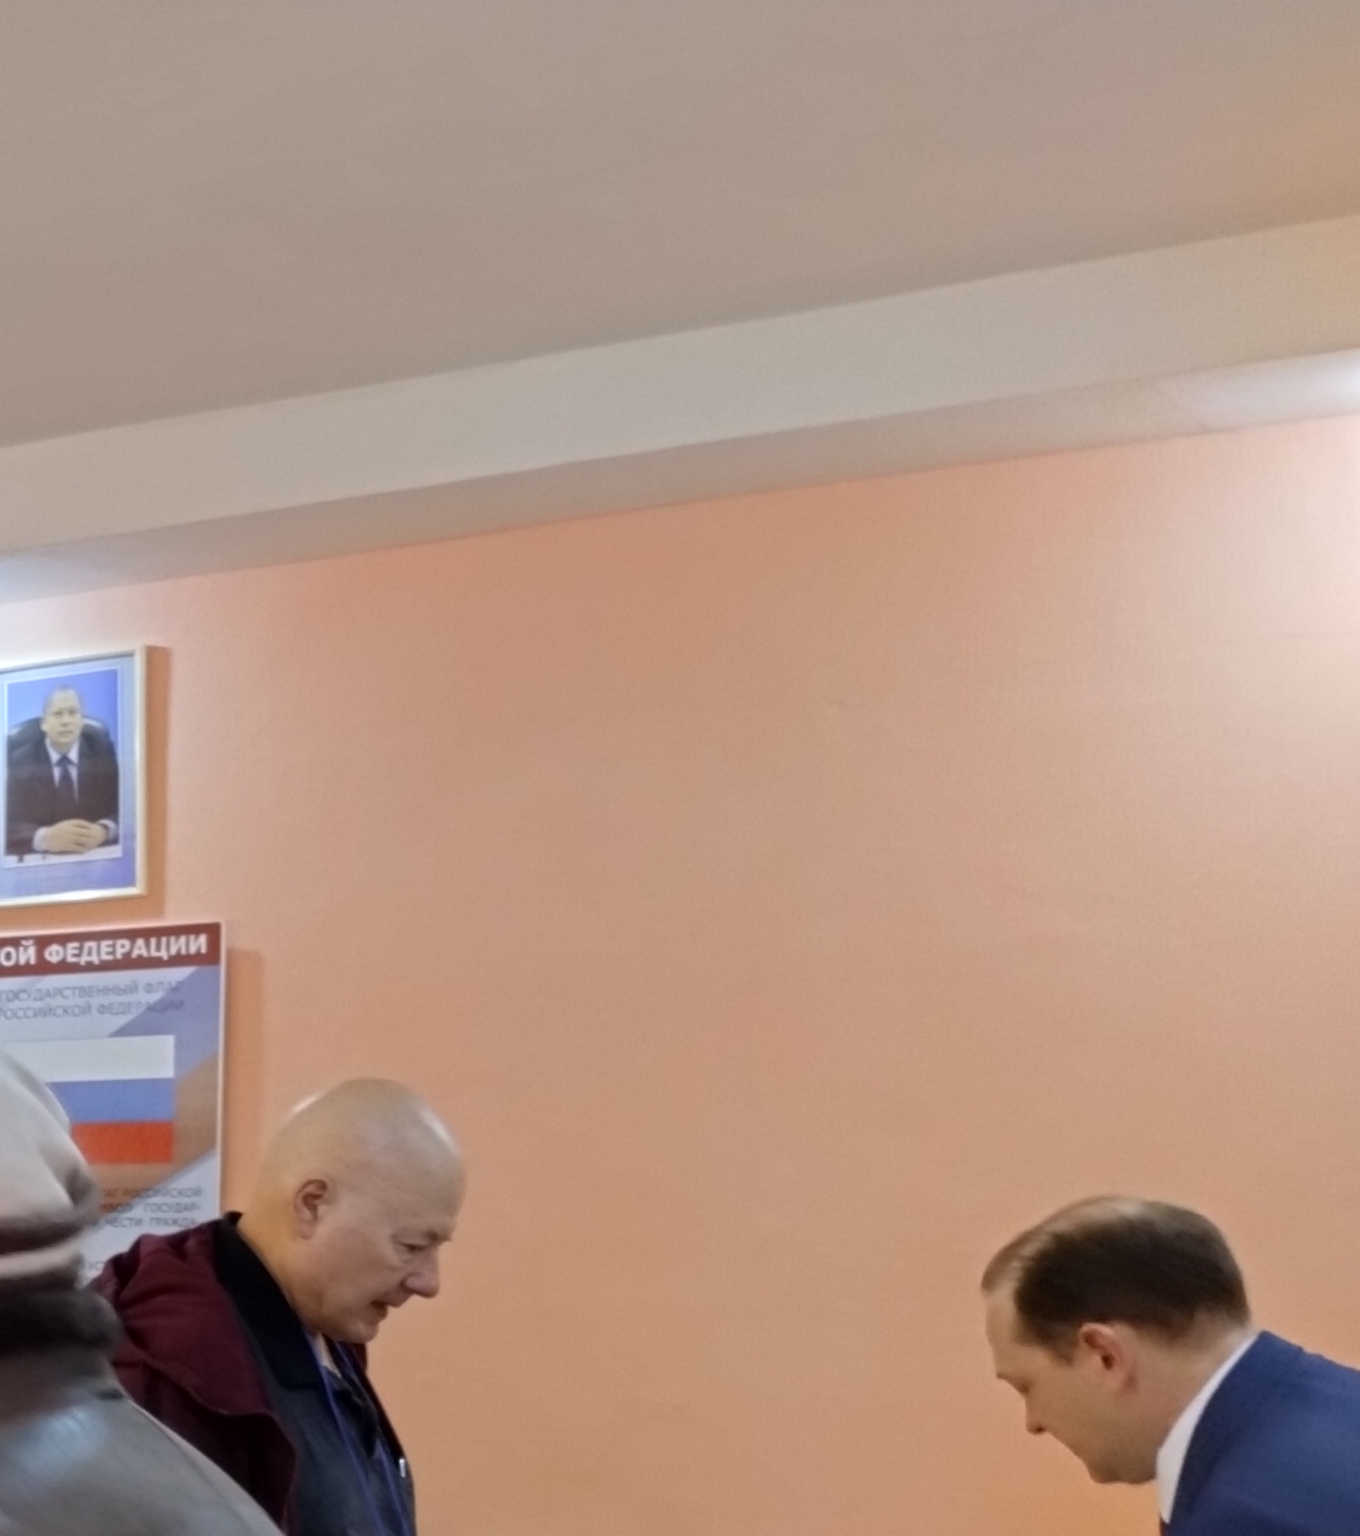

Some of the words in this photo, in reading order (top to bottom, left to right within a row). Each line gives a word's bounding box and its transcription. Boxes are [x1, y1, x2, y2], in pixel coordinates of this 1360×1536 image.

[44, 933, 208, 966] ФЕДЕРАЦИИ
[142, 980, 184, 994] ФЛАГ
[97, 1000, 185, 1016] ФЕДЕРАЦИИ
